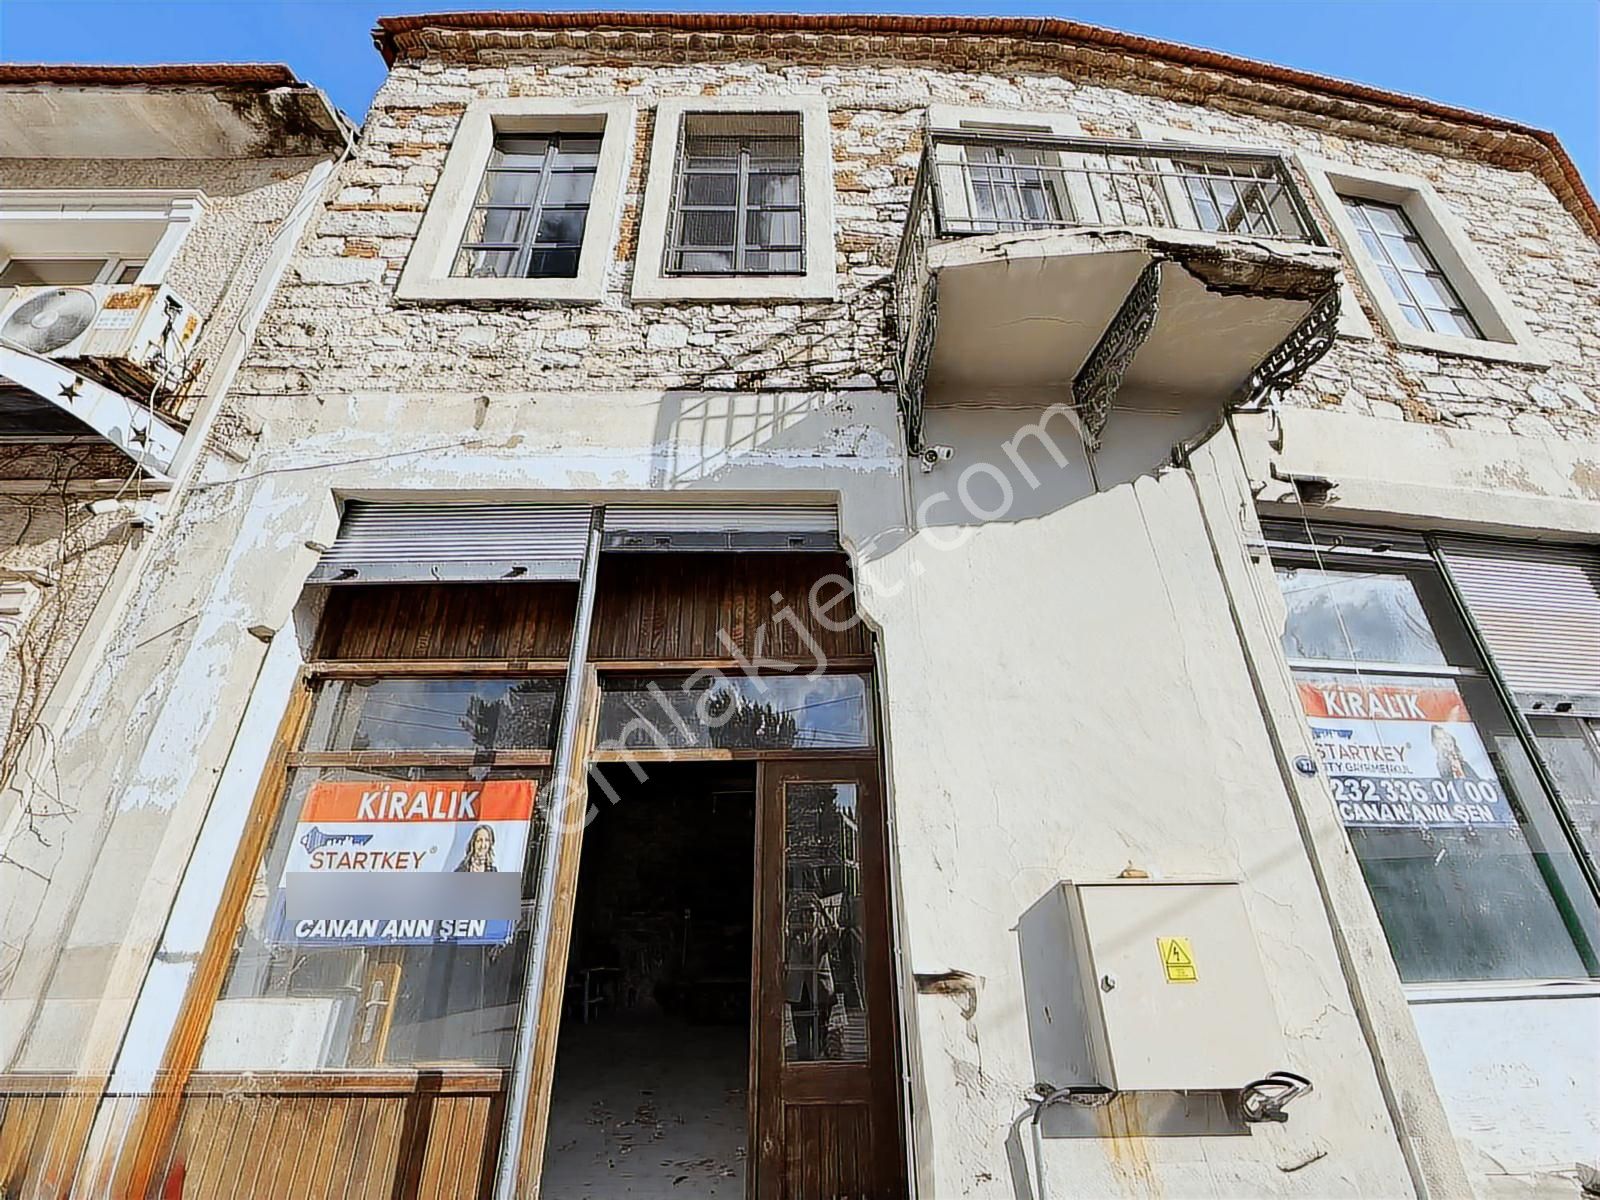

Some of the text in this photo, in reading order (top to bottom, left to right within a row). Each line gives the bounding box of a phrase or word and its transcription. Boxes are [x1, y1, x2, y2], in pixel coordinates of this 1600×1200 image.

[1322, 685, 1427, 719] KİRALIK
[357, 784, 480, 820] KİRALIK
[1381, 780, 1429, 803] 336
[1464, 781, 1498, 803] 00
[1340, 802, 1410, 822] CANAN
[1411, 803, 1453, 822] ANN
[310, 851, 426, 870] STARTKEY
[295, 919, 486, 942] CANAN ANN ŞEN
